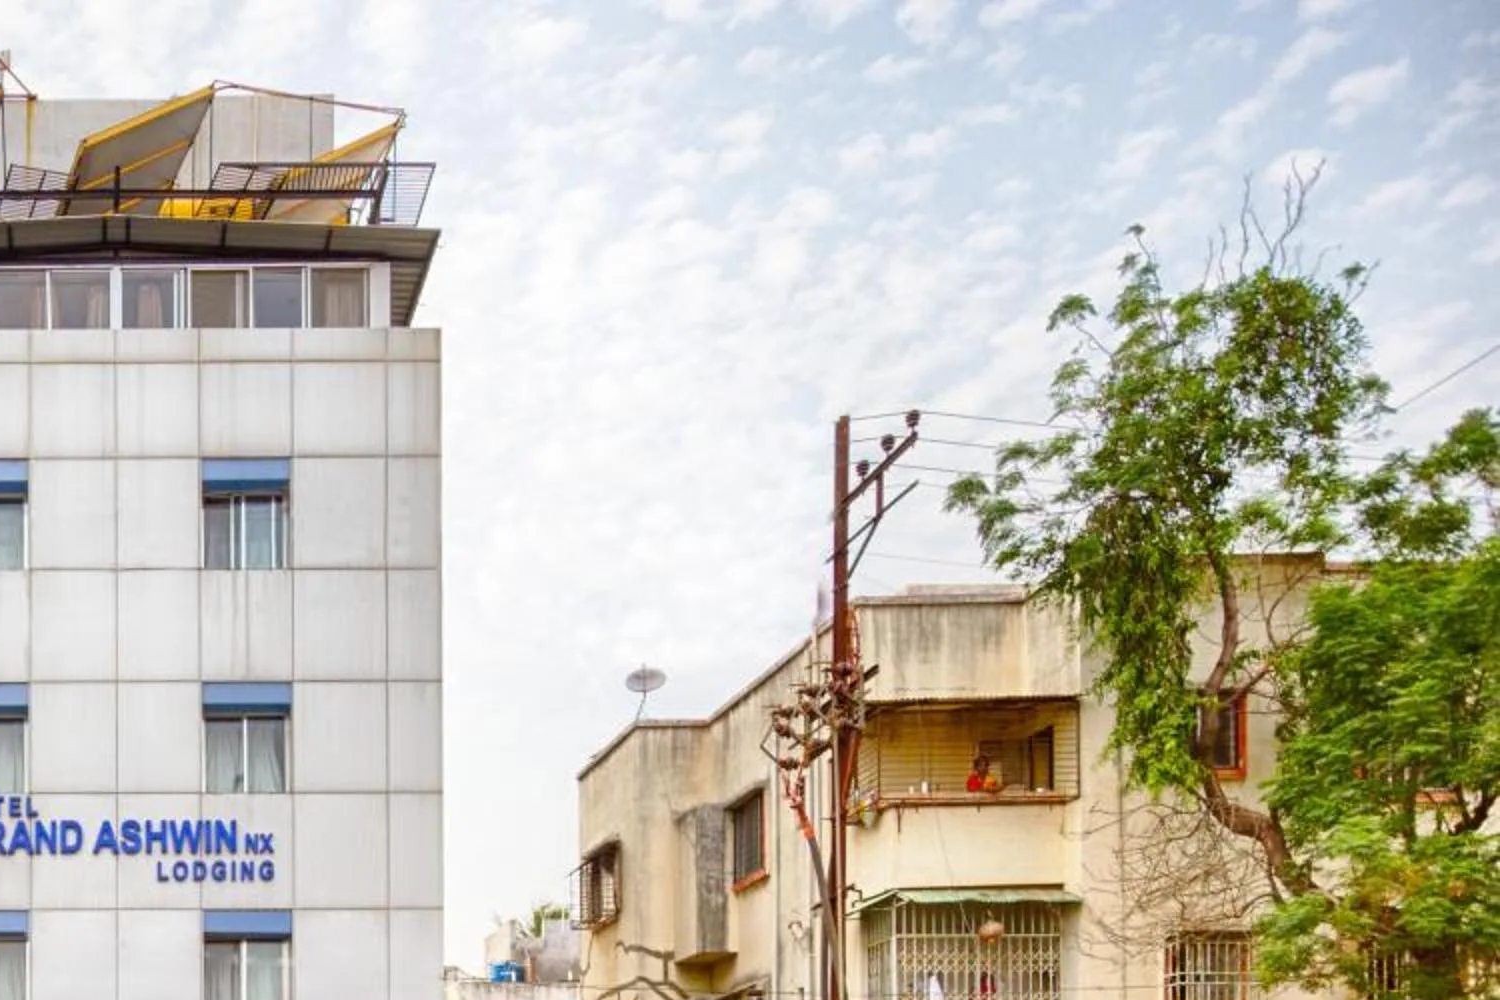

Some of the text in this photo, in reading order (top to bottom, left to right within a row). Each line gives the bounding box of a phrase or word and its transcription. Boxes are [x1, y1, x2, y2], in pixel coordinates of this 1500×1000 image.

[92, 819, 238, 855] ASHWIN
[244, 833, 275, 855] NX
[156, 860, 275, 883] LODGING
